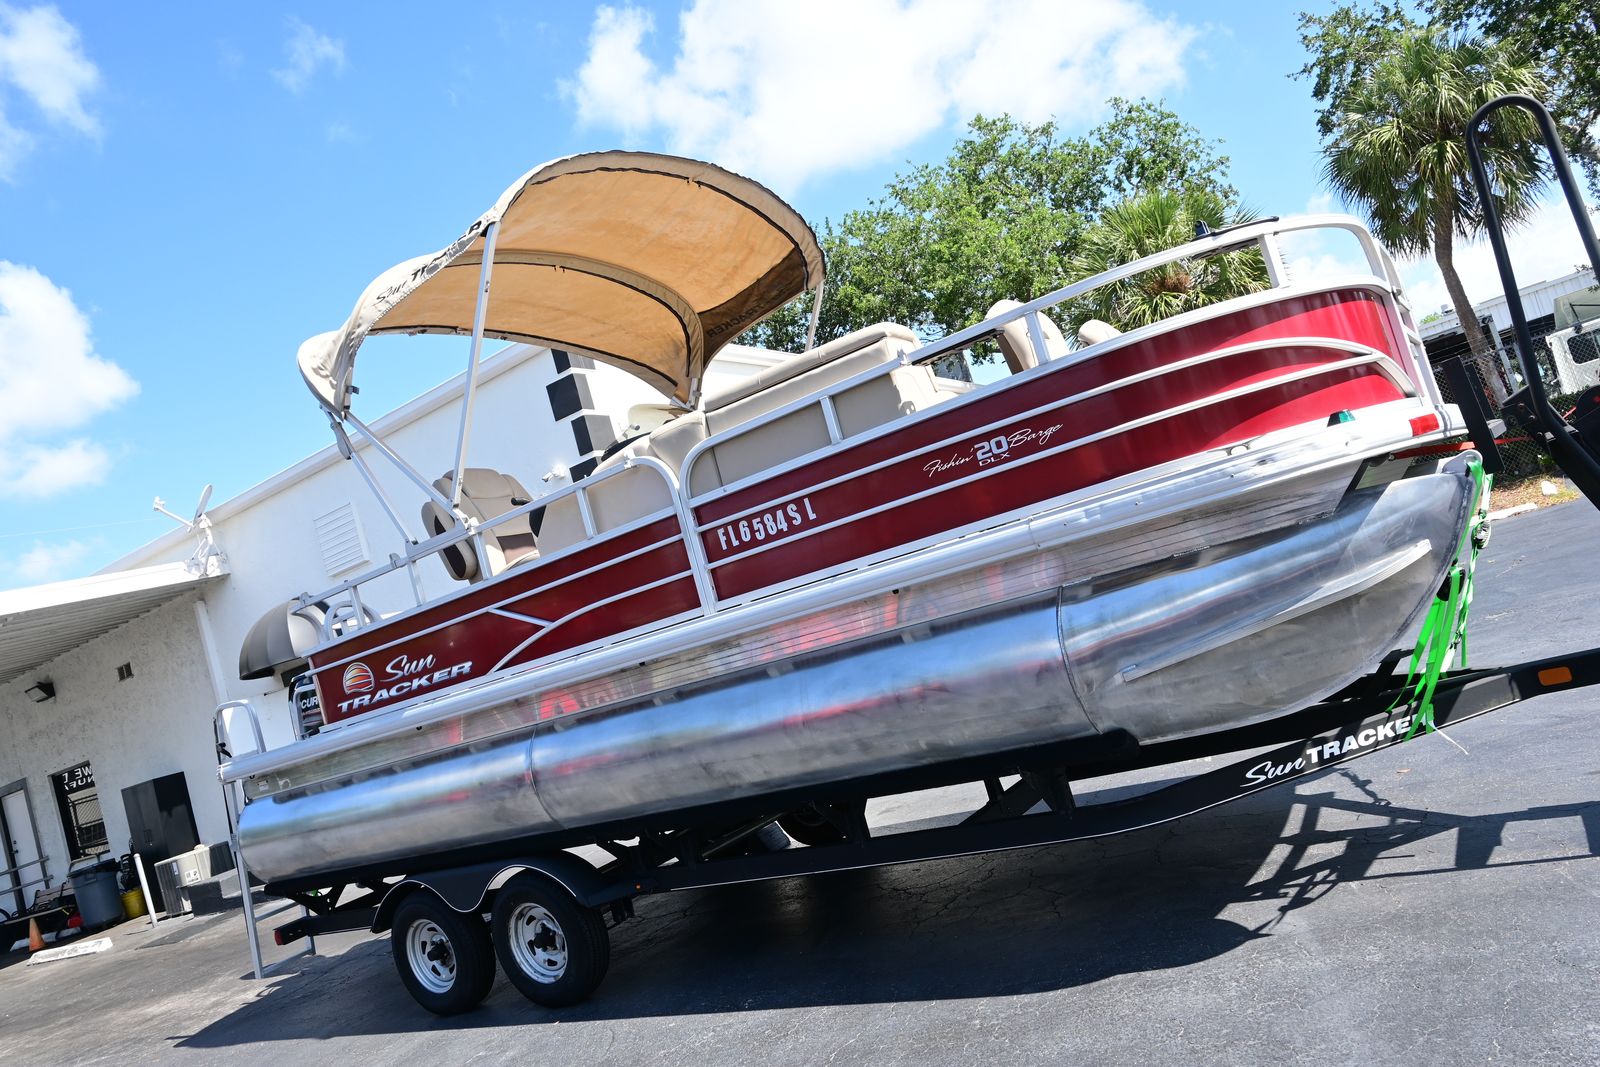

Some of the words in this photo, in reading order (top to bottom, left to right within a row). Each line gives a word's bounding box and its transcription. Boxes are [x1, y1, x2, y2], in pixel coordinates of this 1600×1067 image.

[973, 435, 1009, 461] 20
[1007, 423, 1064, 448] Barge
[978, 450, 1011, 467] DLX
[379, 654, 437, 683] Sun
[337, 660, 473, 714] TRACKER
[1239, 757, 1306, 788] Sun
